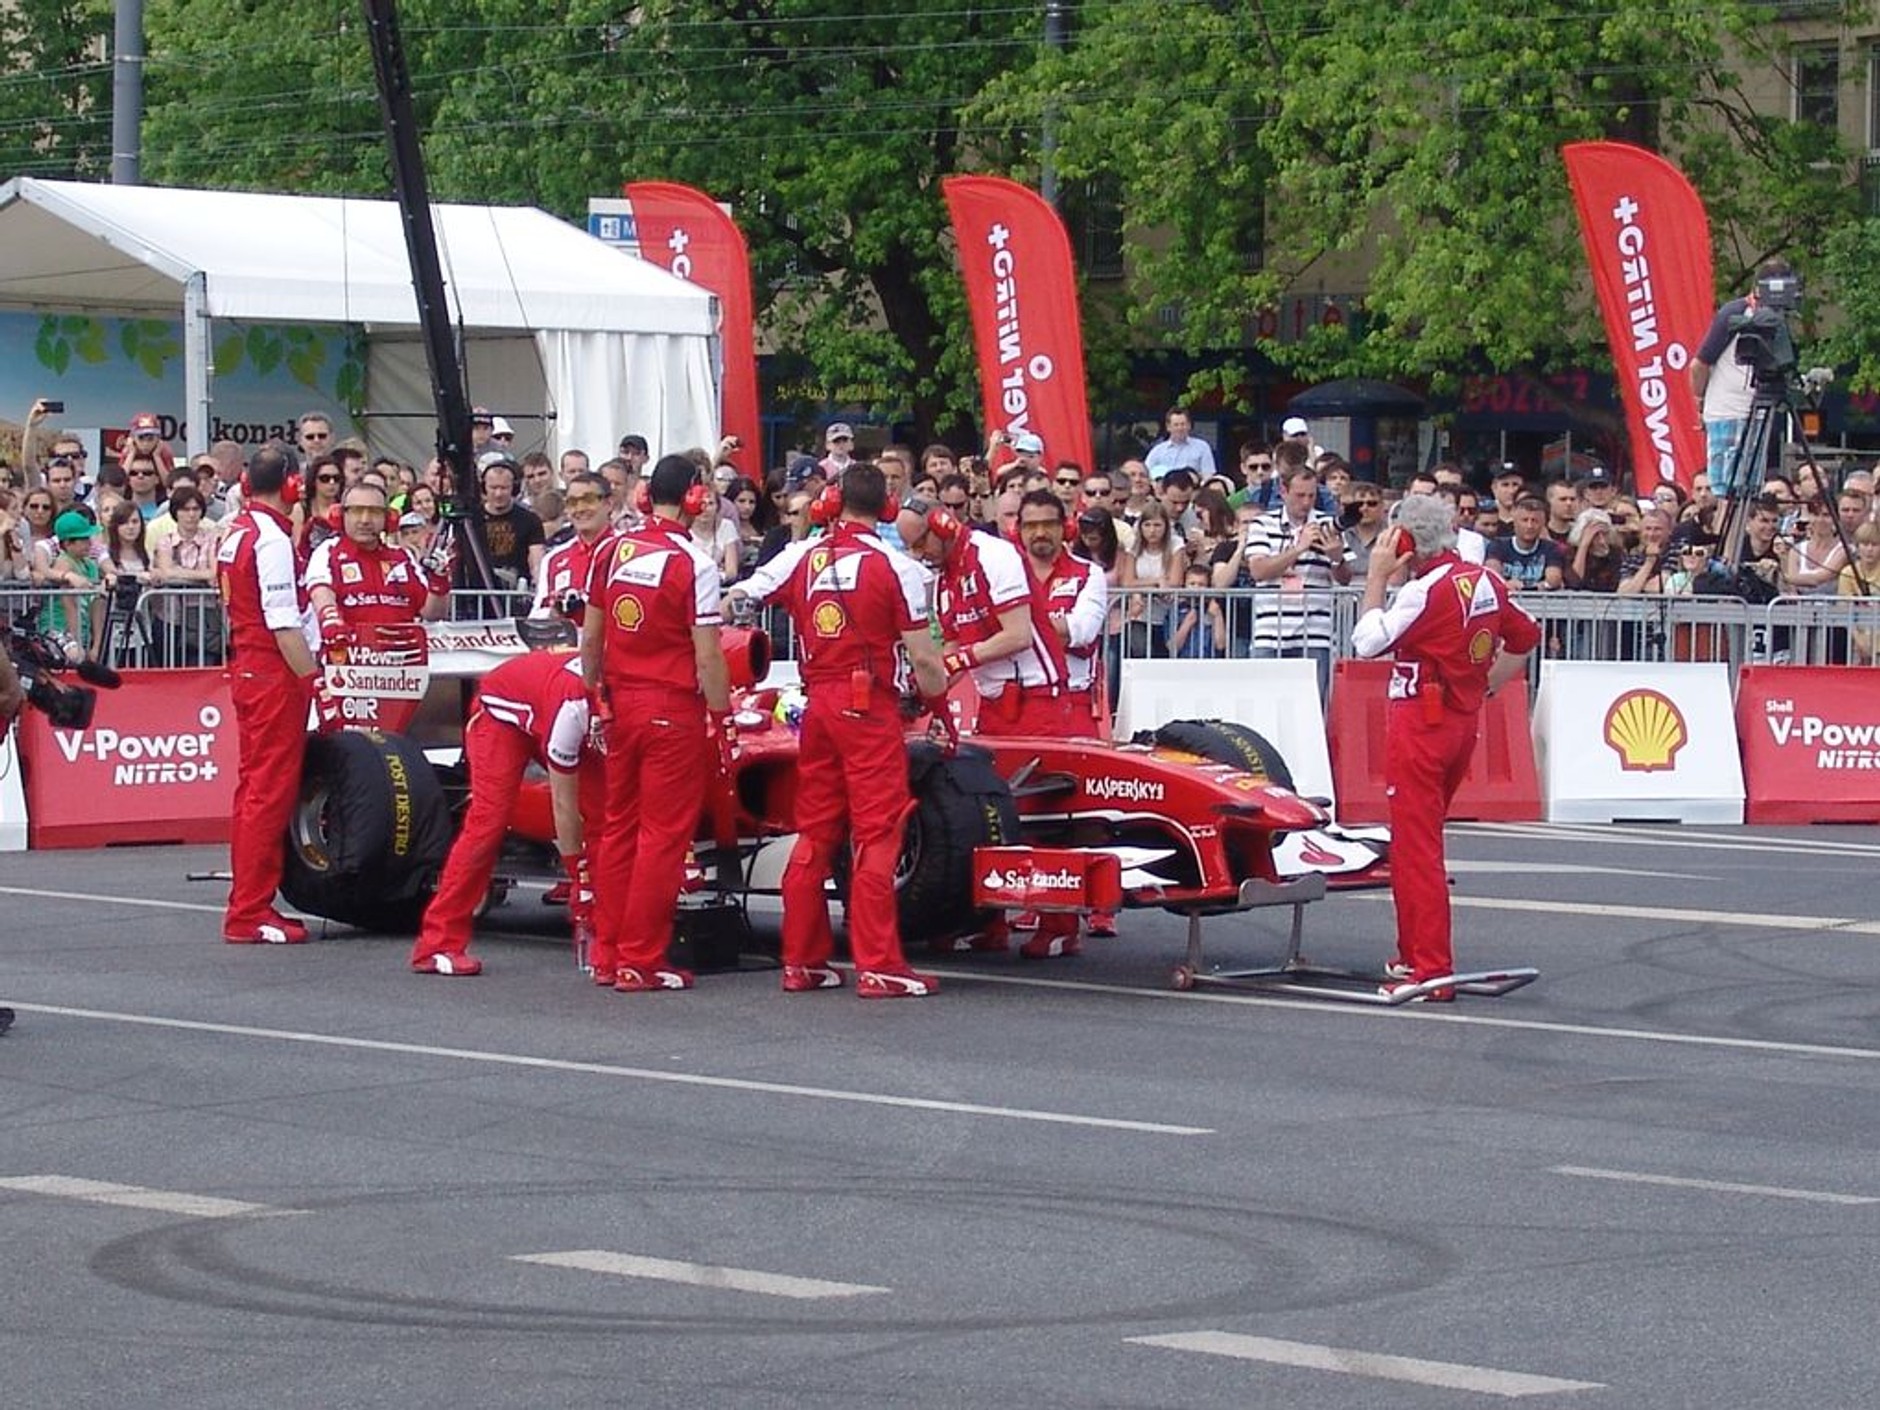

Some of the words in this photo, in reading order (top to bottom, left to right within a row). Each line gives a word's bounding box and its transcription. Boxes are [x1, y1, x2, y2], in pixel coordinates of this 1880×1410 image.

[347, 669, 422, 692] Santander
[54, 729, 215, 762] V-Power
[1767, 716, 1880, 747] V-Pow
